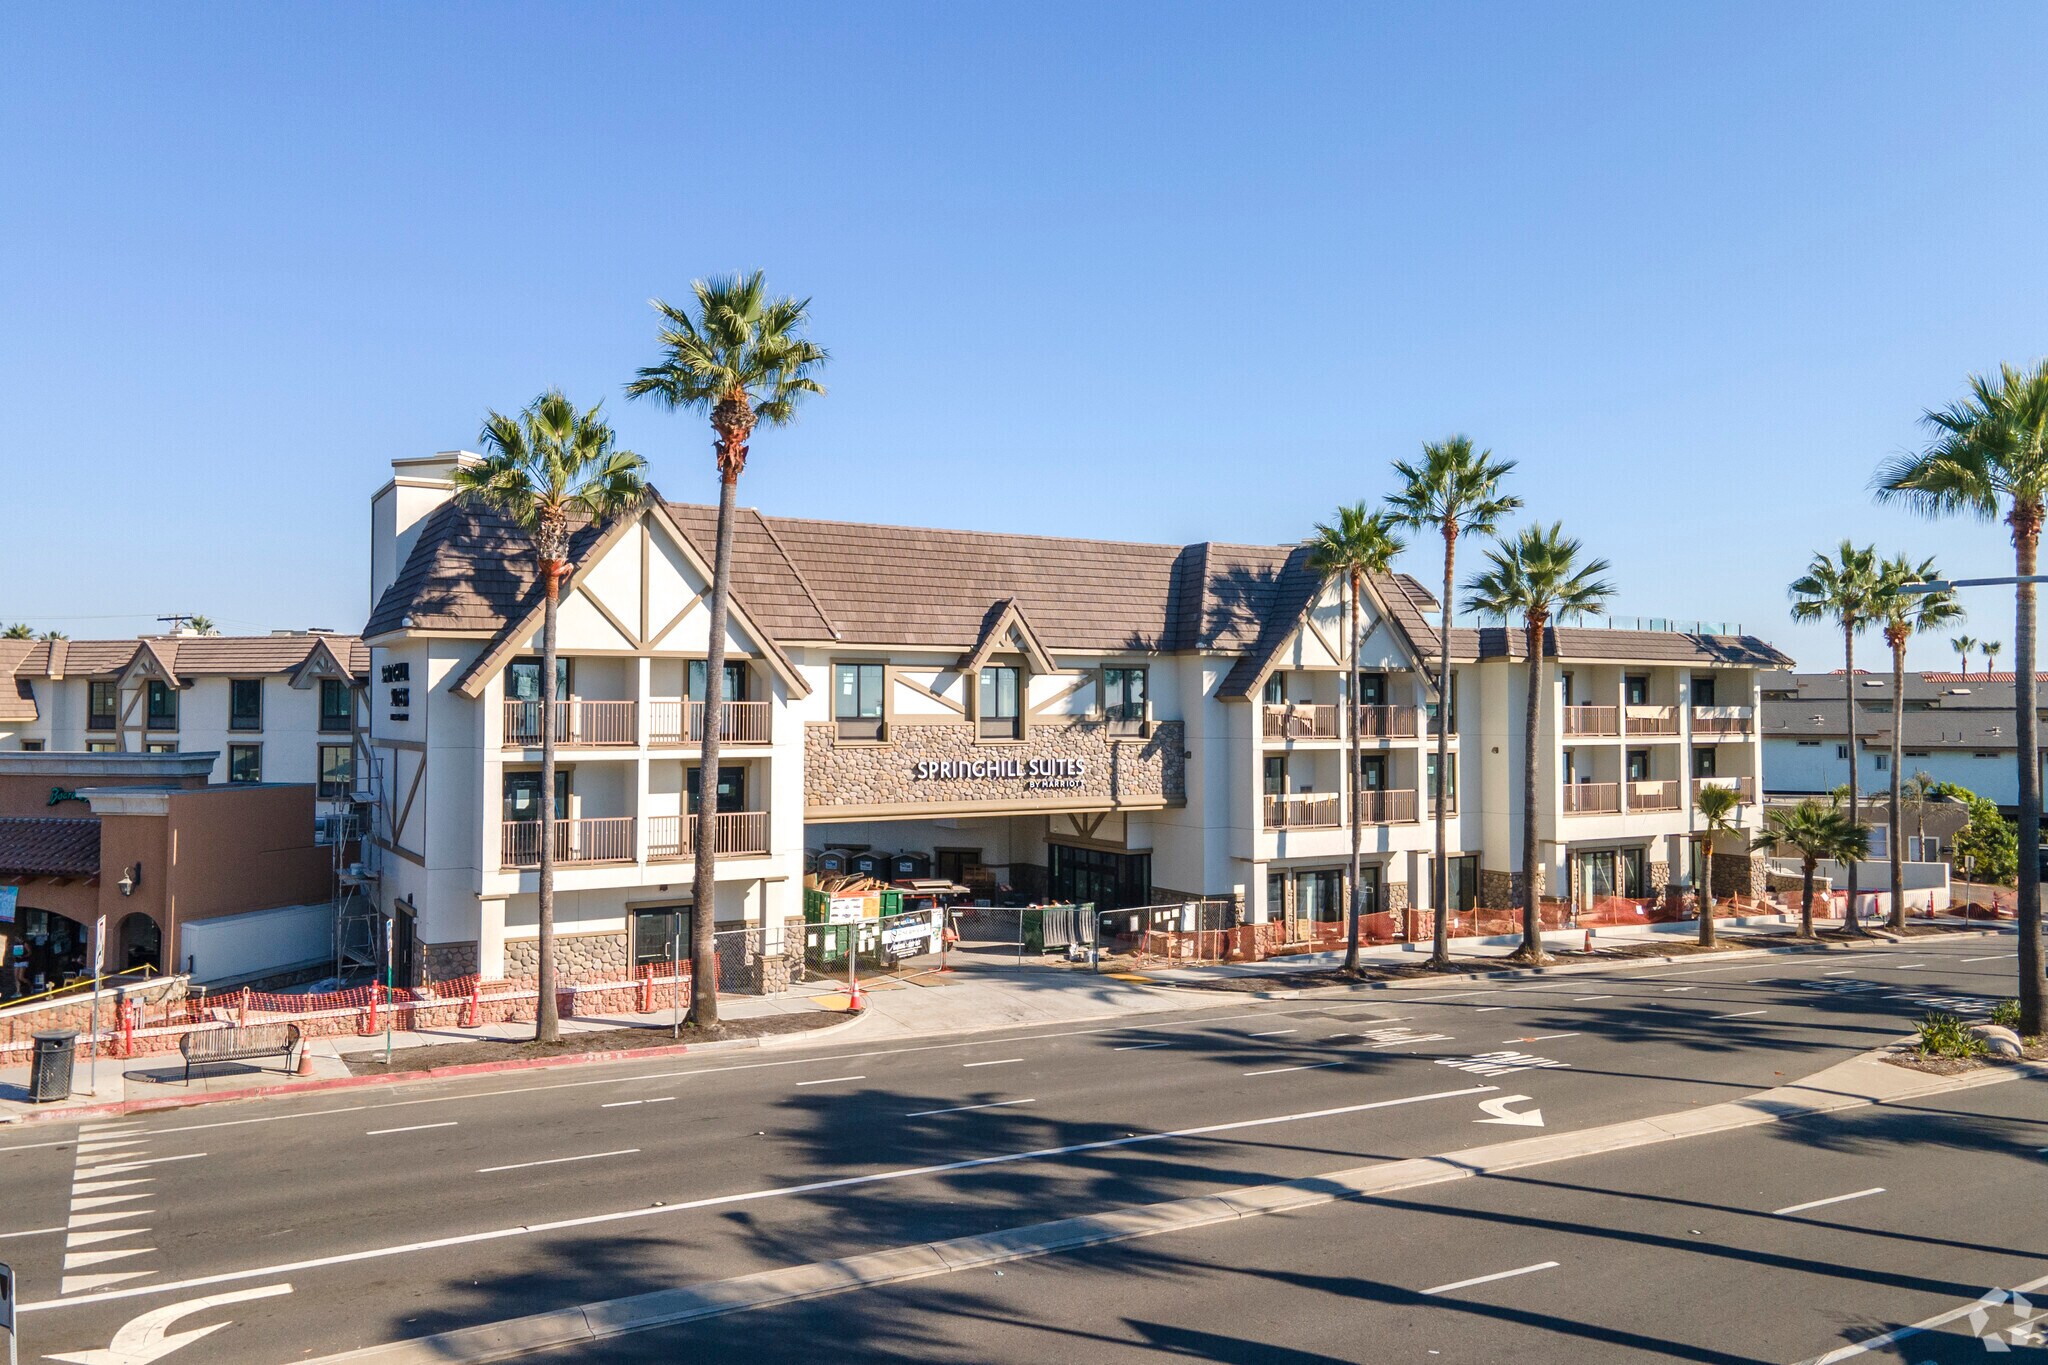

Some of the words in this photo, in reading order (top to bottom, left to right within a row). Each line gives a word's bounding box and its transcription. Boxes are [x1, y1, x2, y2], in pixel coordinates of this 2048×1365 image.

[918, 760, 1022, 778] SPRINGHILL
[1029, 758, 1085, 776] SUITES
[1042, 779, 1085, 788] MARRIOTT
[1434, 1051, 1571, 1077] XING
